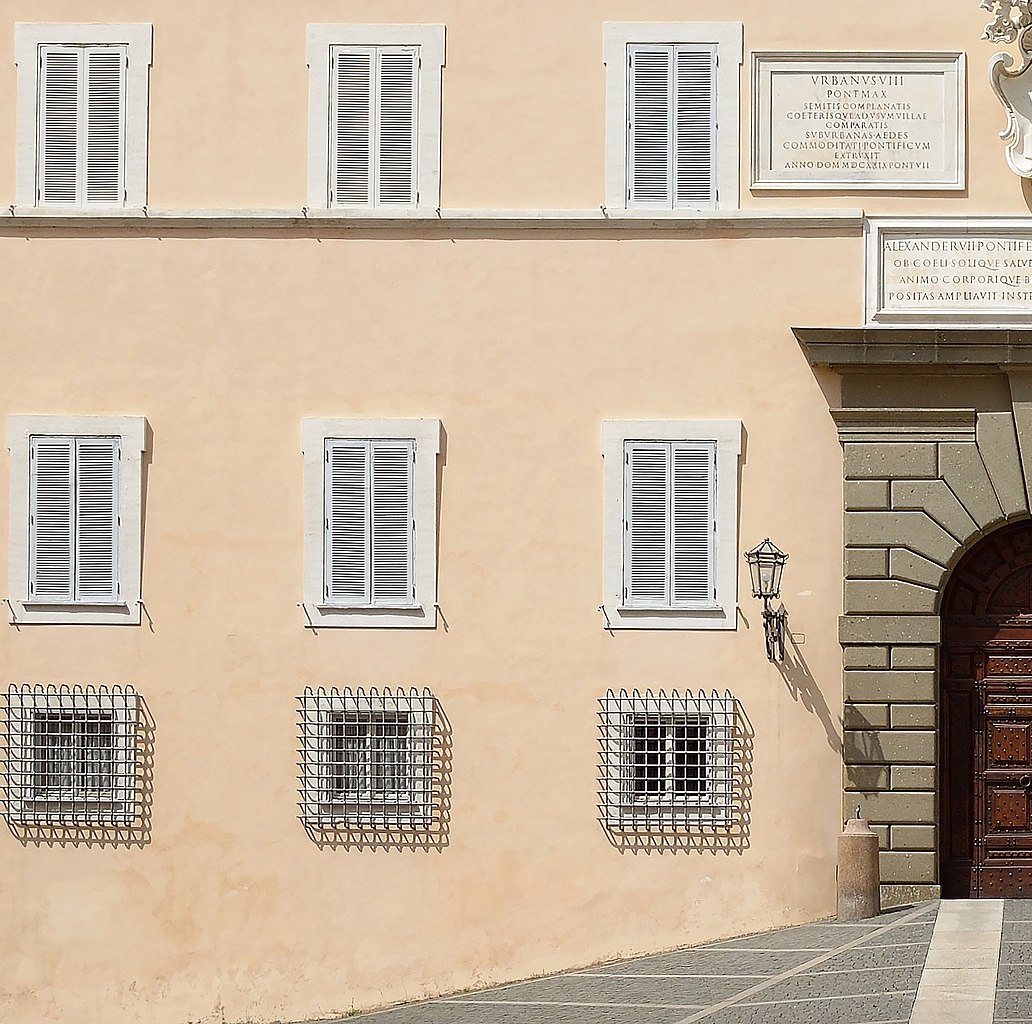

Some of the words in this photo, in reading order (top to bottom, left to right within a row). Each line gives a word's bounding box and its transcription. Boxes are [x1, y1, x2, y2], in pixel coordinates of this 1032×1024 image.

[811, 76, 876, 86] VRBANVS
[879, 76, 904, 86] VIII
[828, 90, 859, 98] PONT
[862, 90, 887, 98] MAX
[864, 142, 930, 150] PONTIFICVM
[885, 242, 958, 251] ALEXANDER
[960, 242, 975, 251] VII
[894, 259, 909, 268] OB
[914, 259, 948, 268] COELI
[900, 276, 938, 284] ANIMO
[942, 276, 1021, 287] CORPORIQVE
[889, 292, 935, 300] POSITAS
